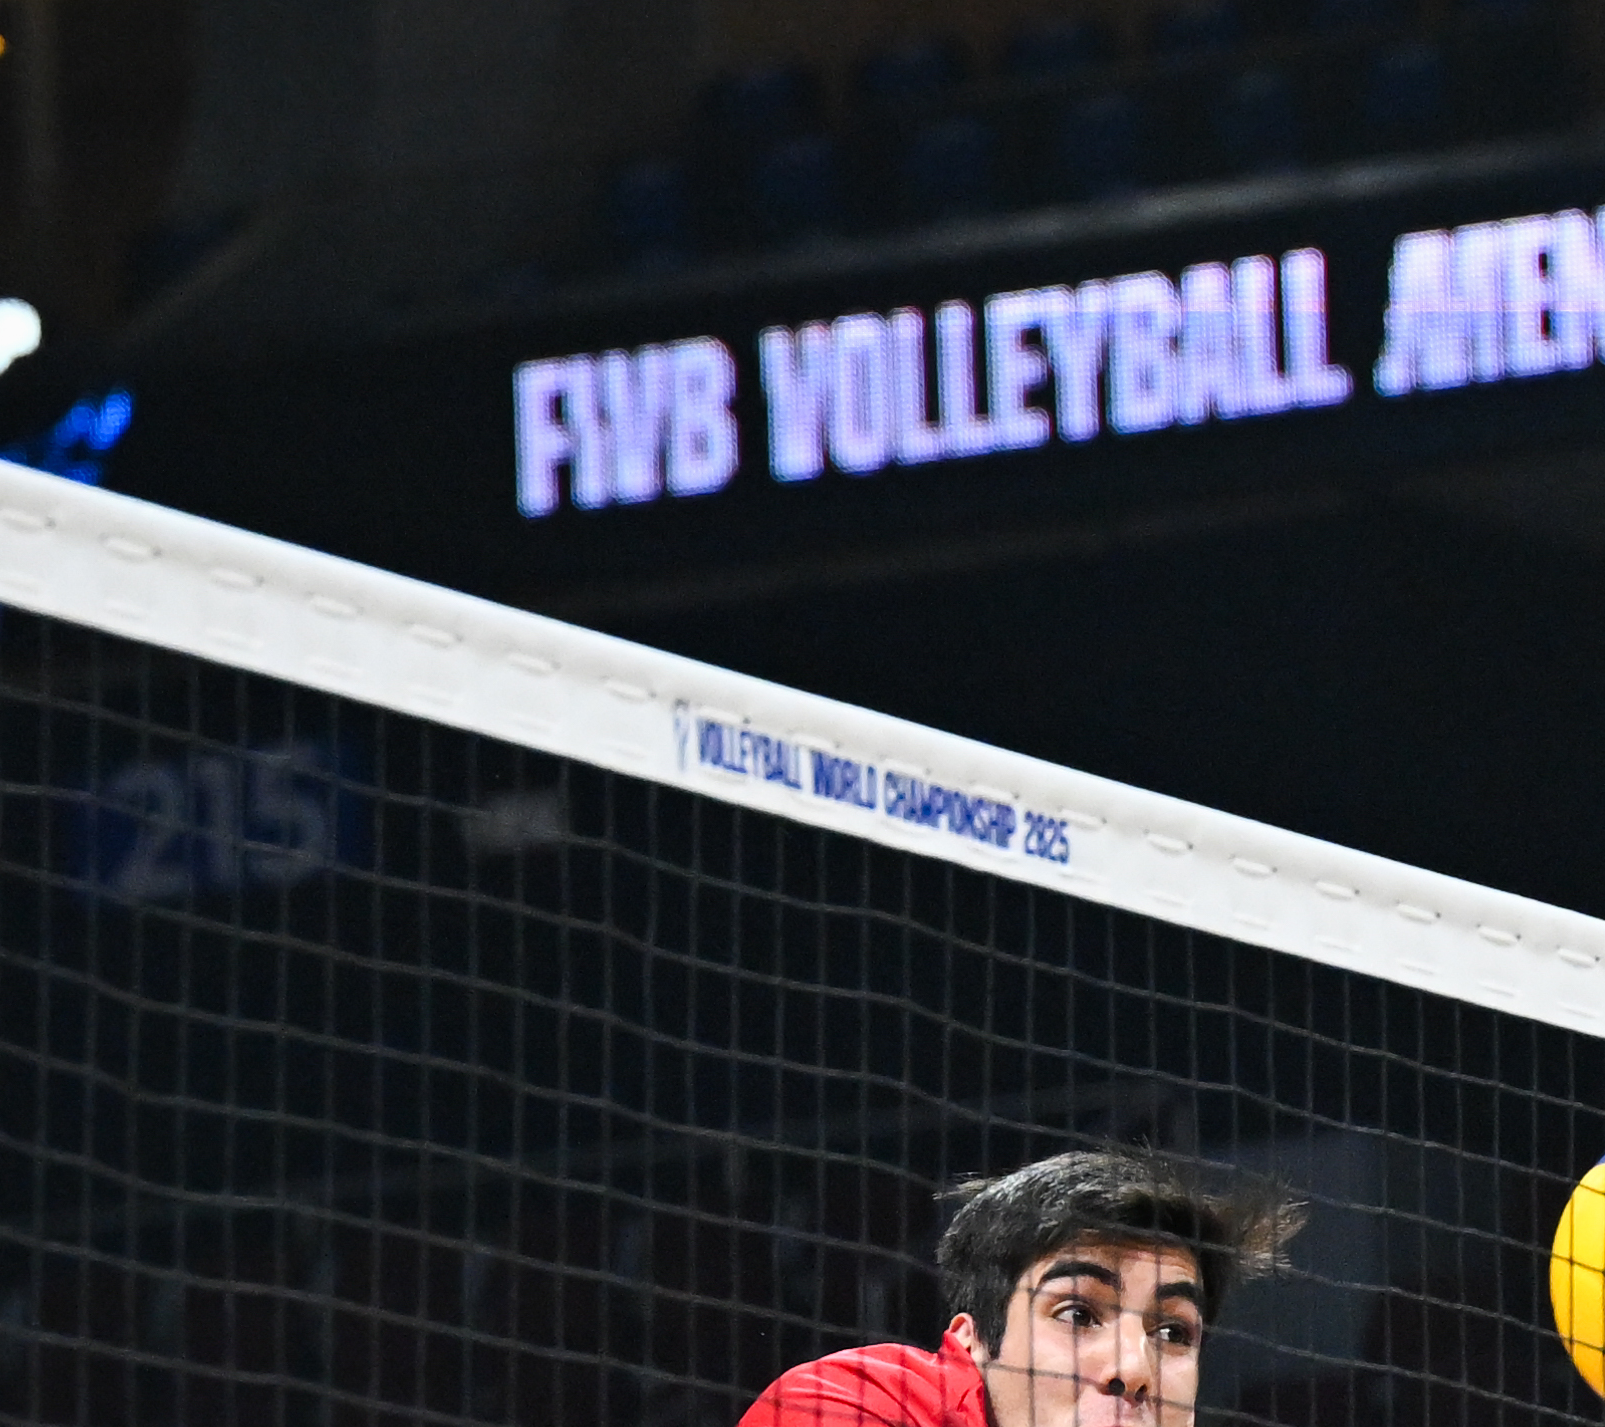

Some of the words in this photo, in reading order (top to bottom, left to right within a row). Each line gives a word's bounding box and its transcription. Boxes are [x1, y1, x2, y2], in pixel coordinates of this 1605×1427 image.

[512, 337, 740, 518] FIVB
[759, 247, 1352, 482] VOLLEYBALL
[699, 718, 803, 791] VOLLEYBALL
[811, 748, 877, 811] WORLD
[884, 770, 1017, 850] CHAMPIONSHIP
